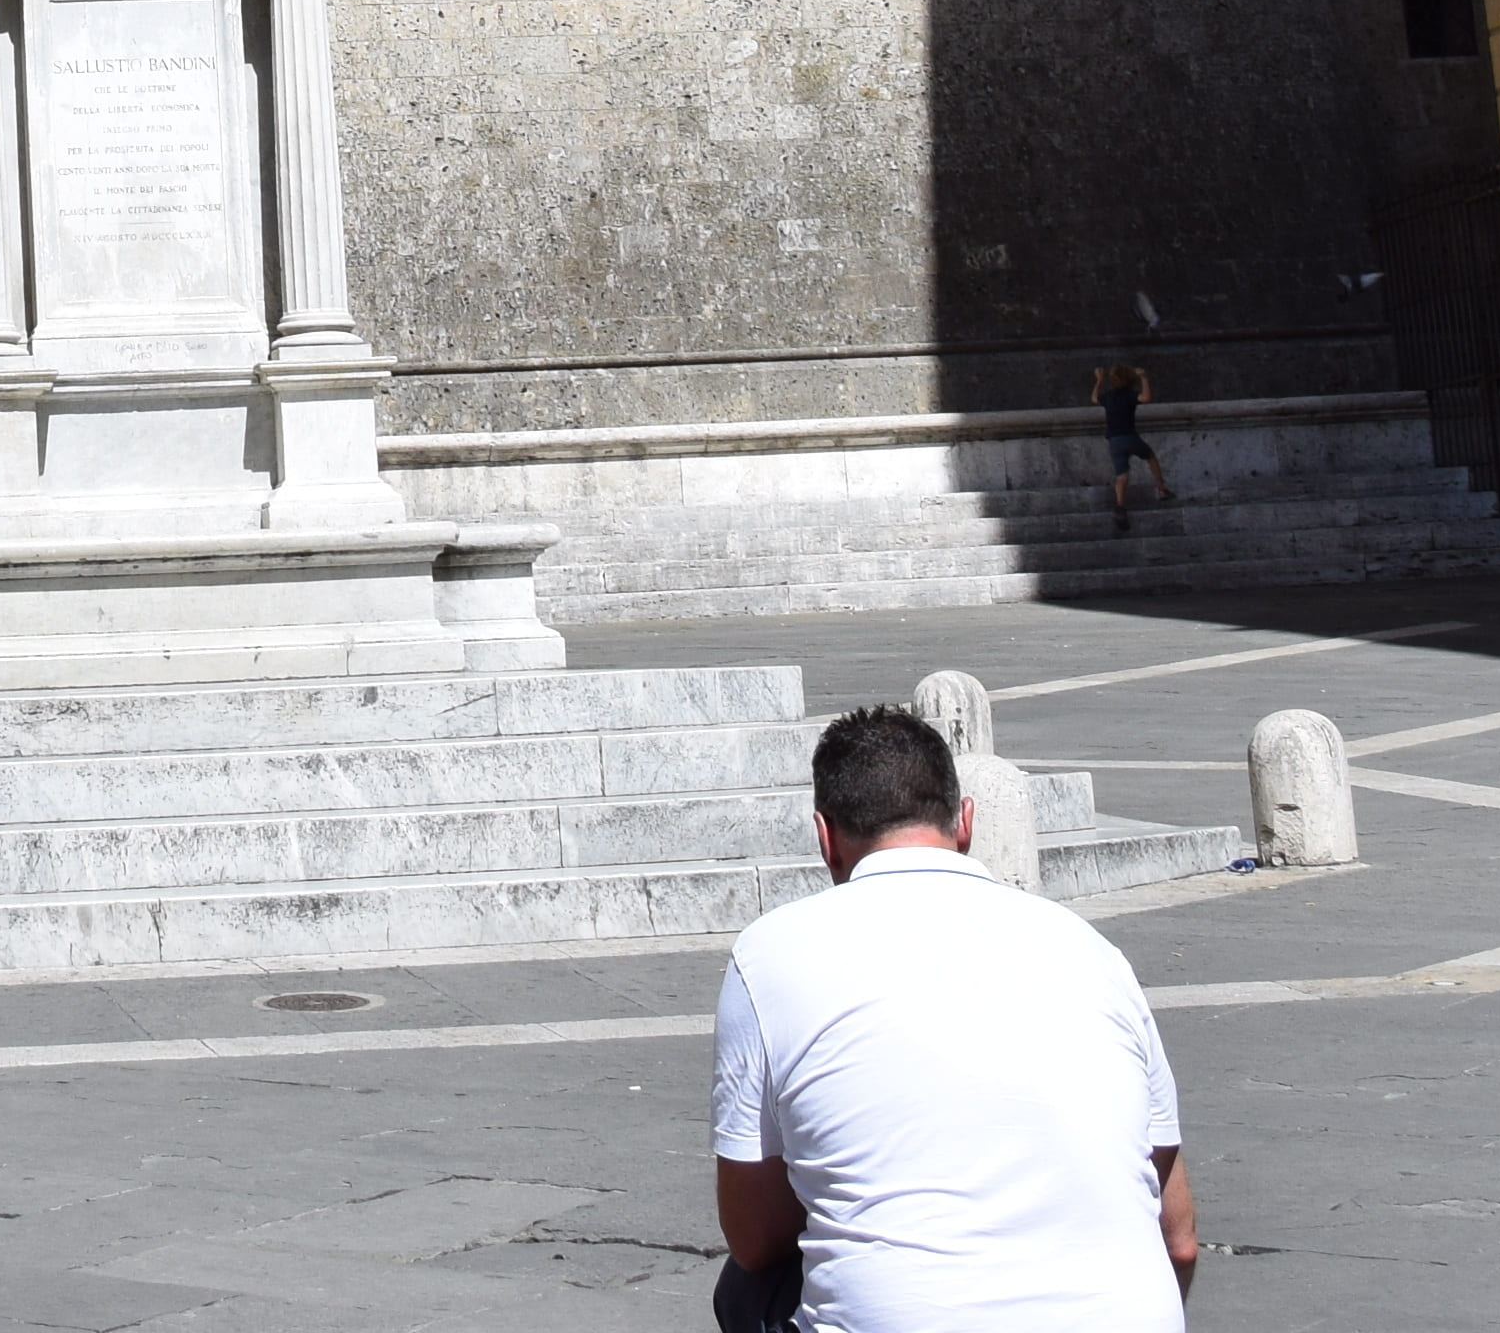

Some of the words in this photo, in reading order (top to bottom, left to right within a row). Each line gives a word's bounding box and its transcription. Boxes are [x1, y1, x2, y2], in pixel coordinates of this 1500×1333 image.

[52, 57, 142, 75] SALLUSTIO
[148, 56, 216, 72] BANDINI
[94, 84, 112, 94] CHE
[117, 84, 129, 94] LE
[72, 106, 101, 116] DELLA
[67, 146, 83, 156] PER
[88, 145, 99, 155] LA
[160, 144, 174, 153] DEI
[179, 142, 209, 153] POPOLI
[57, 166, 86, 177] CENTO
[113, 165, 133, 174] ANNI
[136, 164, 159, 174] DOPO
[106, 185, 136, 195] MONTE
[139, 185, 154, 194] DEI
[158, 183, 187, 194] PASCHI
[111, 205, 122, 215] LA
